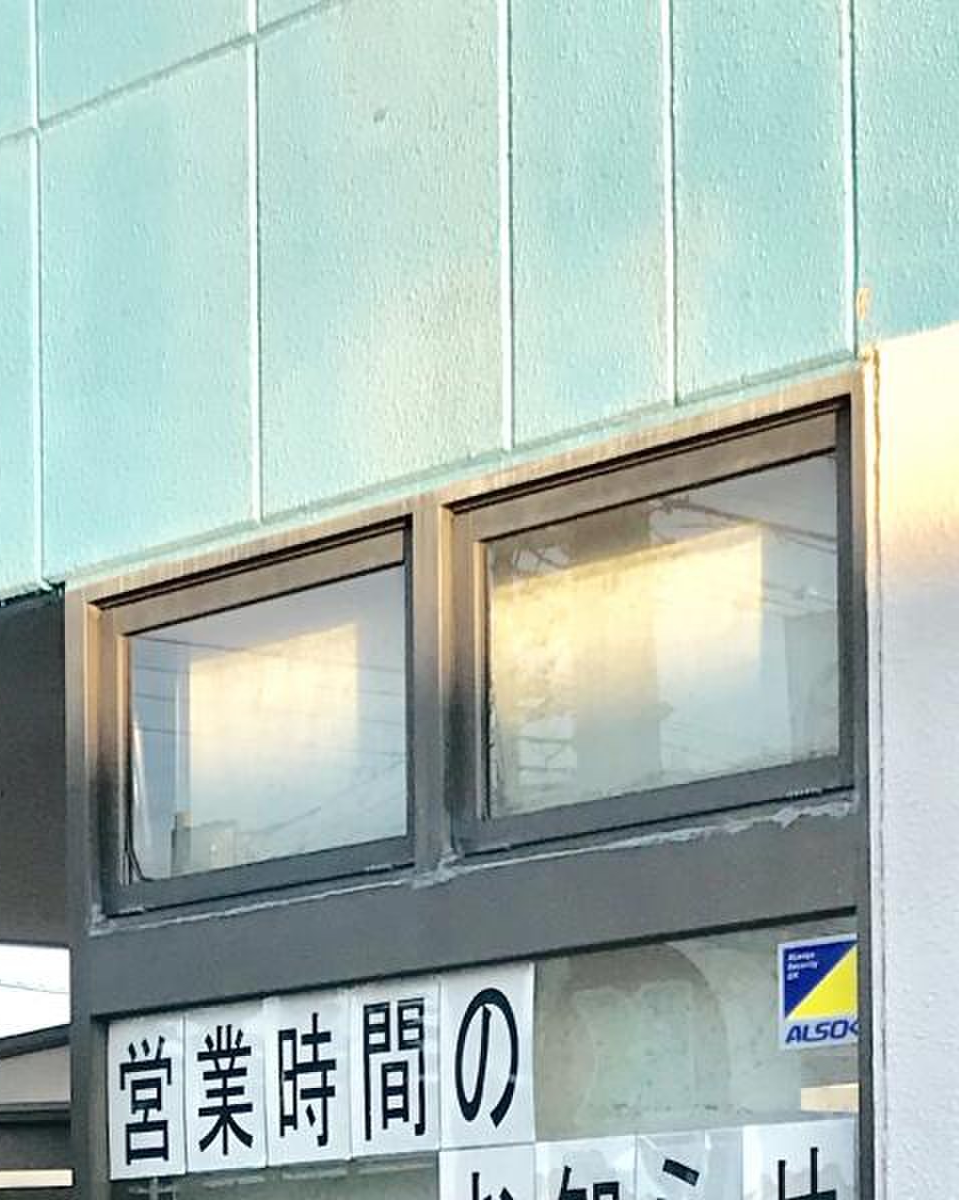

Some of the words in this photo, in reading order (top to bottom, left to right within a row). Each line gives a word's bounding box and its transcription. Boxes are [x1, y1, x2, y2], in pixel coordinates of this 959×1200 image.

[118, 987, 520, 1165] 営業時間の
